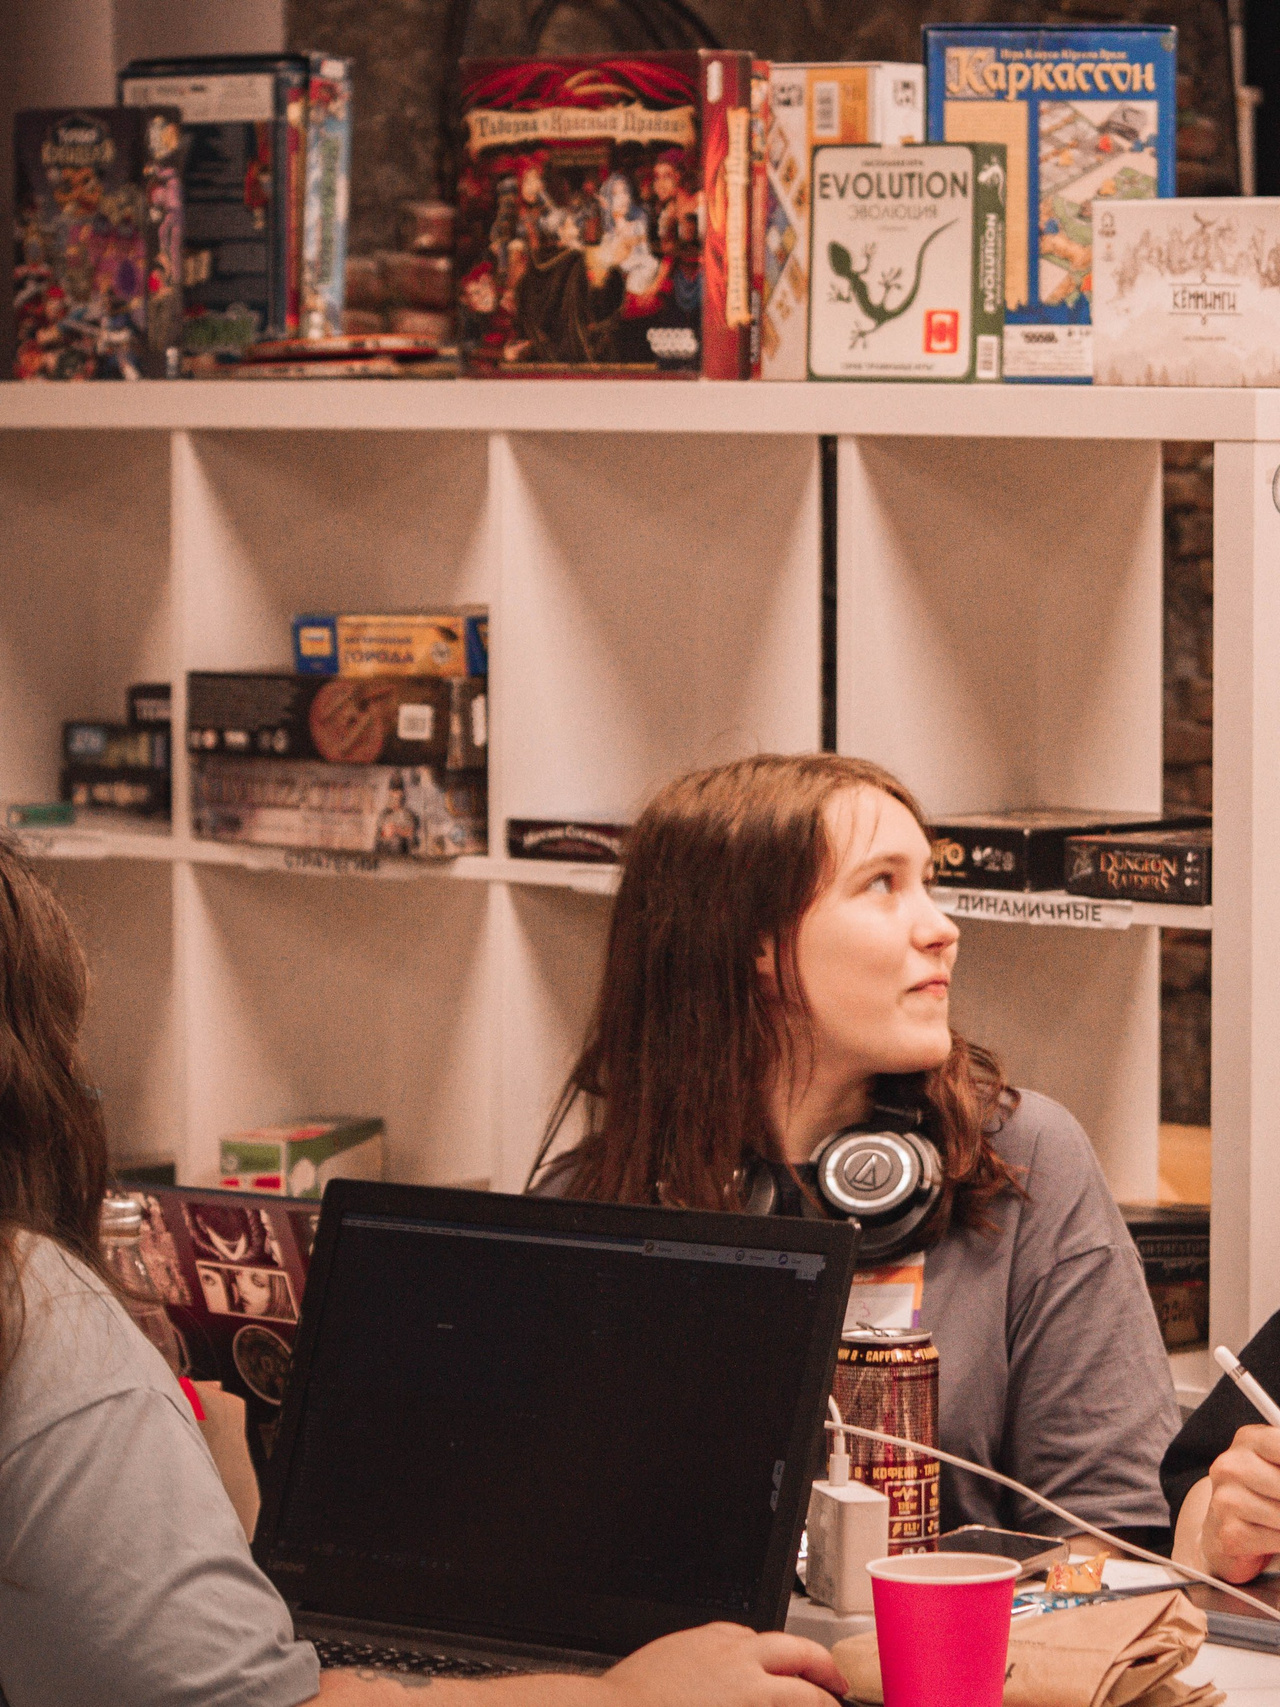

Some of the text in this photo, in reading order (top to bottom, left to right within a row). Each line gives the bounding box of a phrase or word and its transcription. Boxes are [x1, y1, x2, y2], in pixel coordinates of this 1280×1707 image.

[946, 50, 1156, 101] Каркассон
[819, 171, 968, 200] EVOLUTION
[983, 213, 997, 313] EVOLUTION
[1100, 852, 1178, 877] DUNGEON
[1107, 871, 1170, 892] RAIDERS
[956, 894, 1102, 922] ДИНАМИЧНЫЕ
